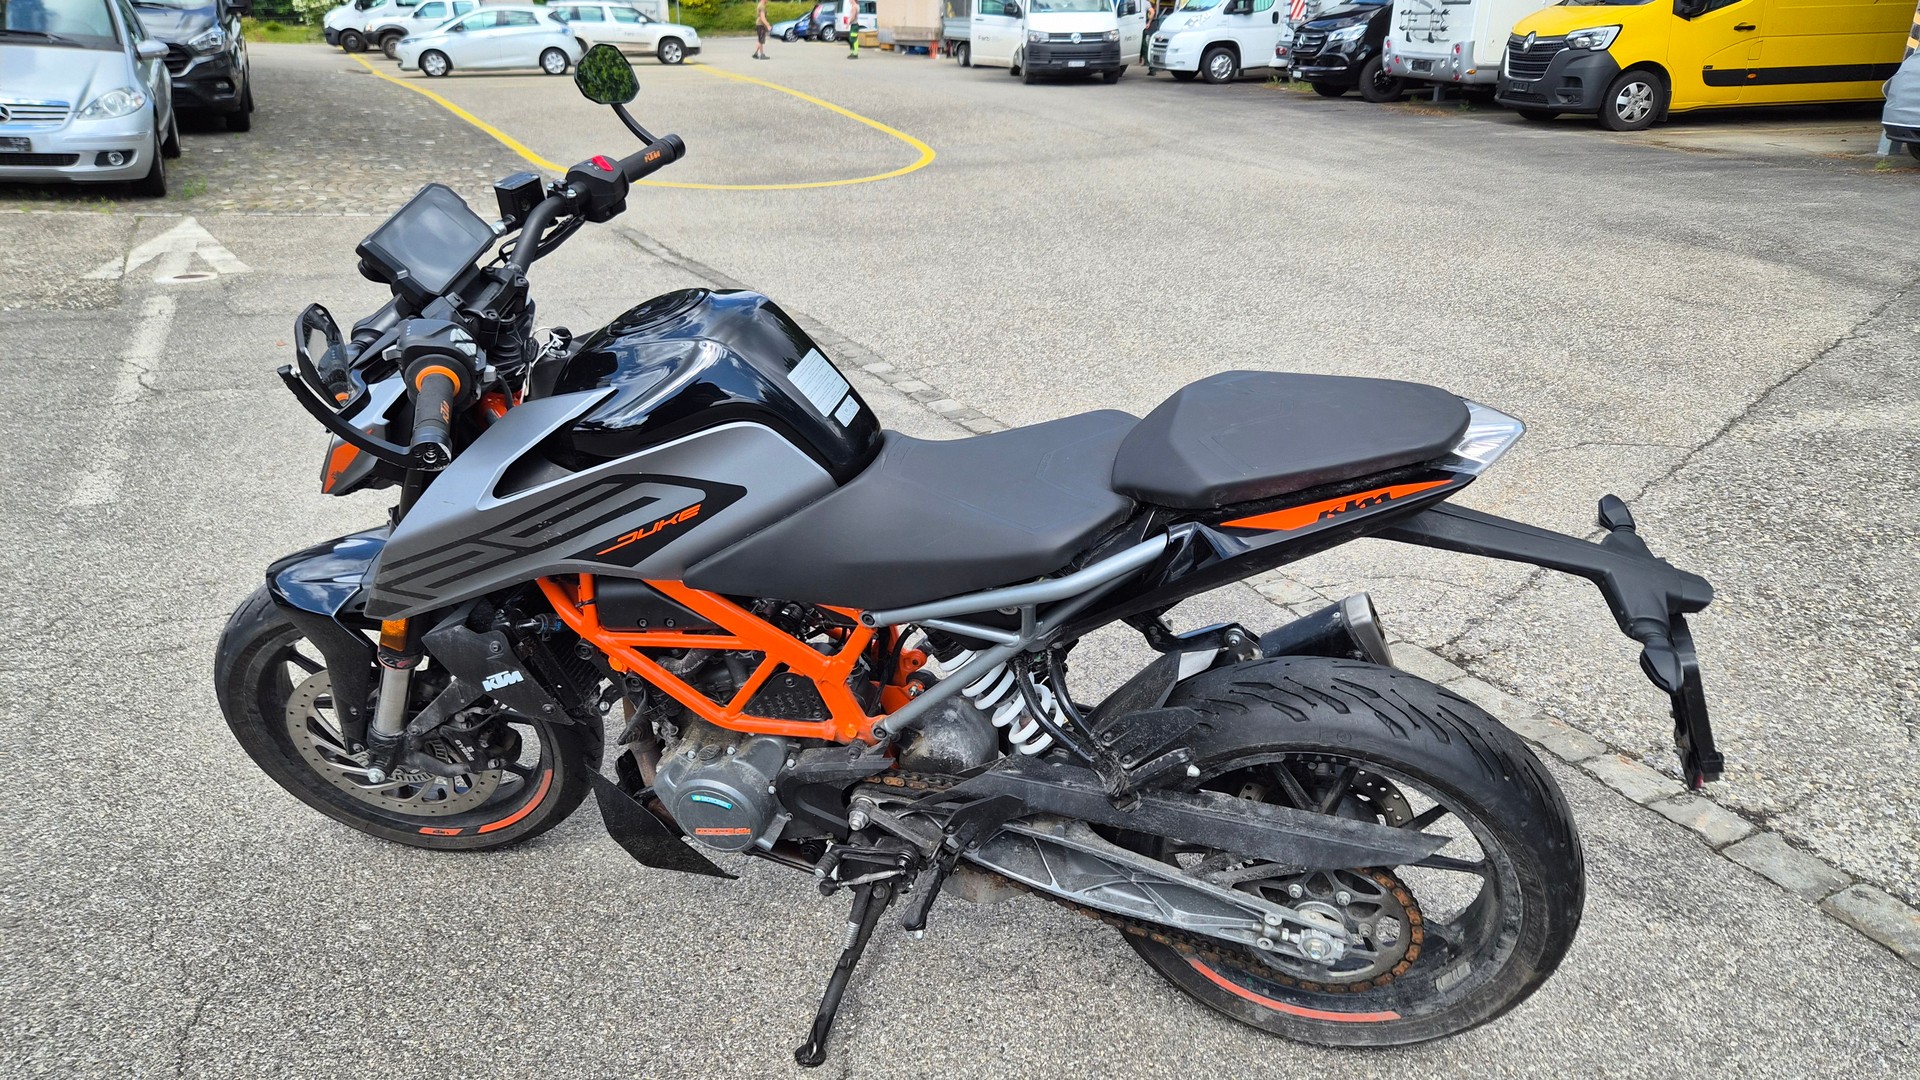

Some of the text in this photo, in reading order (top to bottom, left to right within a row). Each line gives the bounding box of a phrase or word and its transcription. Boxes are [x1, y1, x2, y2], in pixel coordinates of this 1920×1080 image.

[644, 150, 661, 163] KTM
[1318, 491, 1393, 521] KTM
[596, 503, 702, 556] DUKE
[481, 670, 525, 692] KTM
